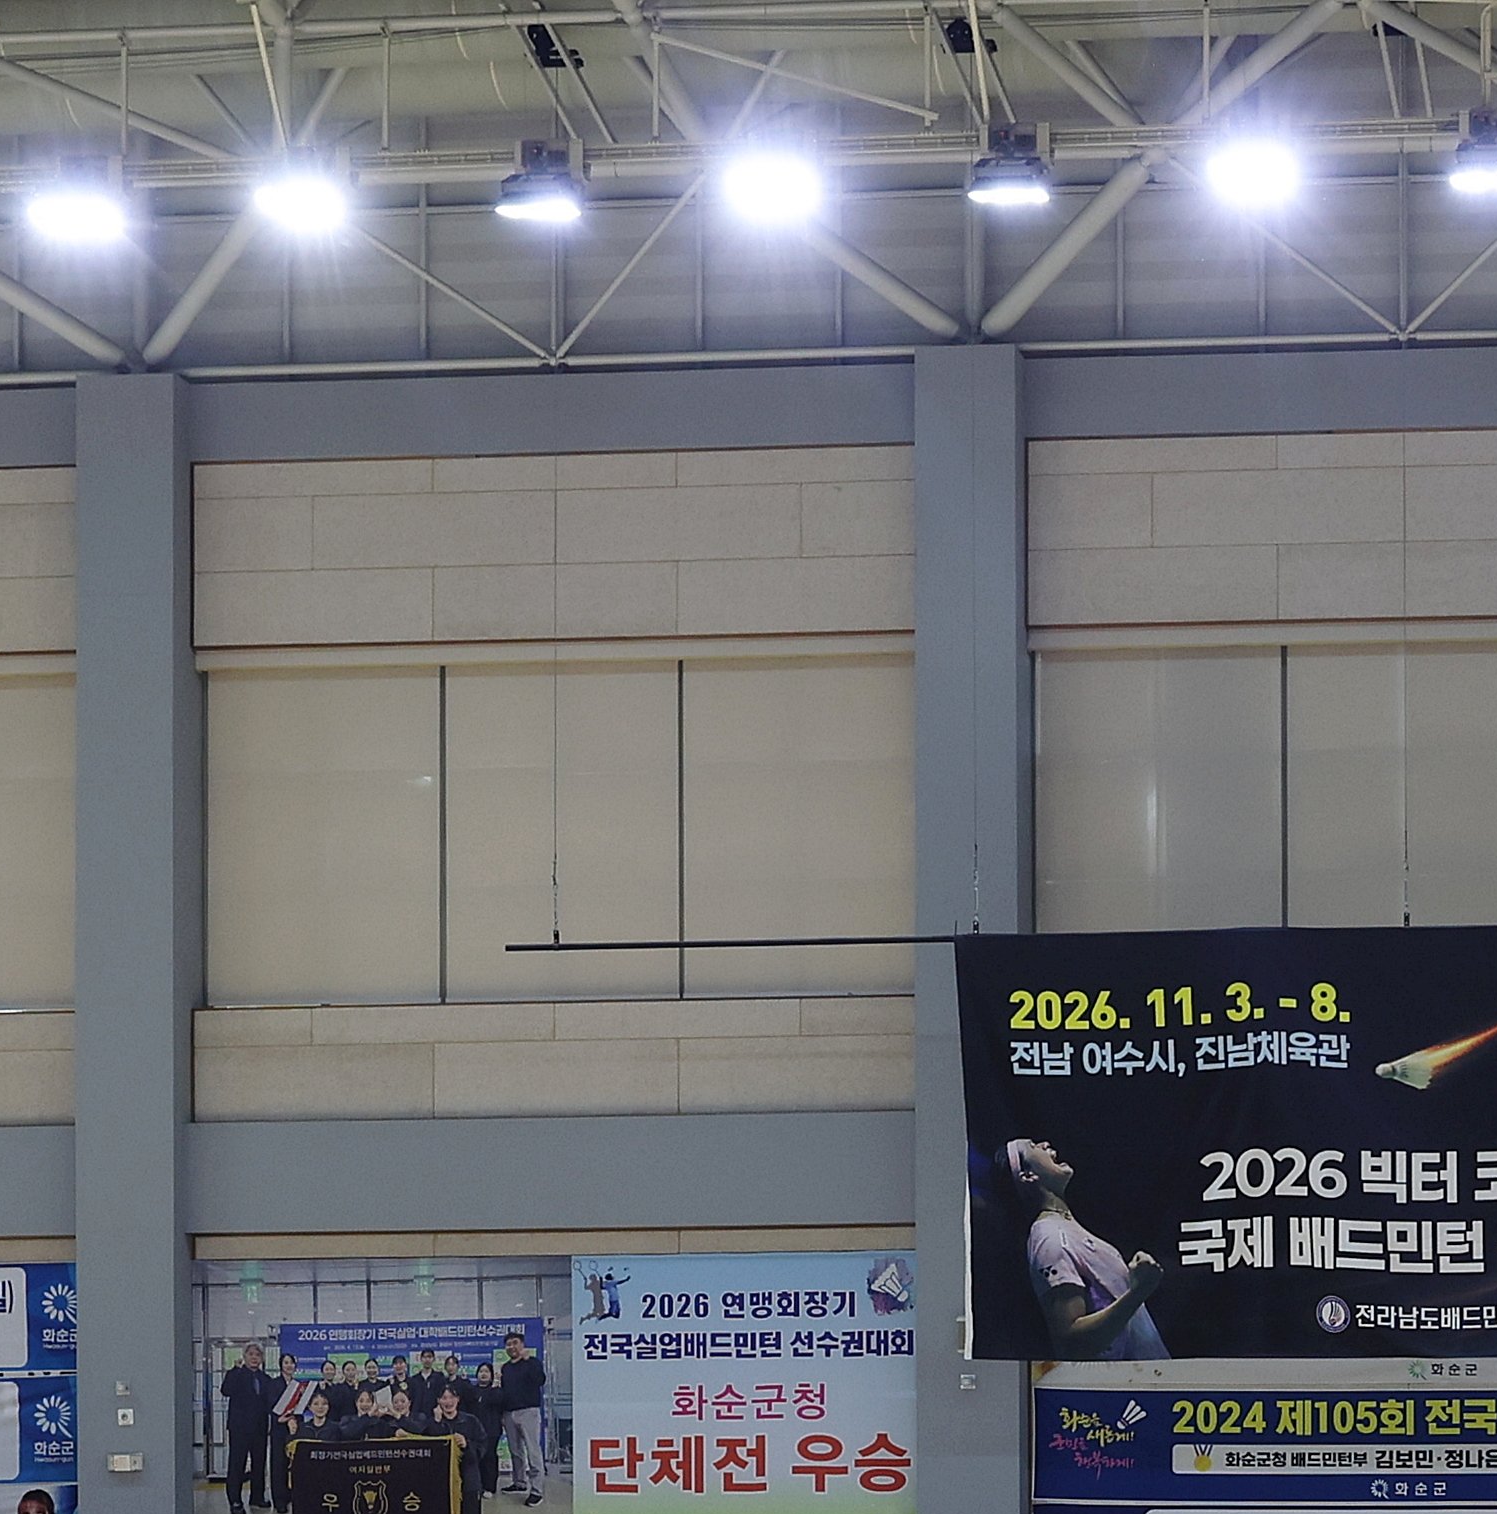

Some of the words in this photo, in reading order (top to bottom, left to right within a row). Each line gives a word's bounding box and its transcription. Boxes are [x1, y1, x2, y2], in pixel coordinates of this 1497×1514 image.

[1010, 990, 1131, 1029] 2026.
[1146, 986, 1211, 1027] 11.
[1226, 982, 1264, 1022] 3.
[1310, 982, 1350, 1022] 8.
[1011, 1041, 1073, 1075] 전남
[1082, 1039, 1184, 1077] 여수시,
[1195, 1031, 1349, 1071] 진남체육관
[1200, 1147, 1347, 1201] 2026
[1360, 1150, 1457, 1203] 빅터
[1178, 1216, 1274, 1272] 국제
[1290, 1217, 1485, 1274] 배드민턴
[641, 1293, 710, 1319] 2026
[721, 1290, 856, 1318] 연맹회장기
[583, 1332, 782, 1361] 전국실업배드민턴
[790, 1329, 914, 1358] 선수권대회
[671, 1382, 827, 1421] 화순군청
[1172, 1400, 1267, 1435] 2024
[1276, 1399, 1414, 1436] 제105회
[589, 1434, 768, 1495] 단체전
[791, 1432, 912, 1494] 우승
[1225, 1452, 1286, 1468] 화순군청
[1291, 1451, 1368, 1468] 배드민턴부
